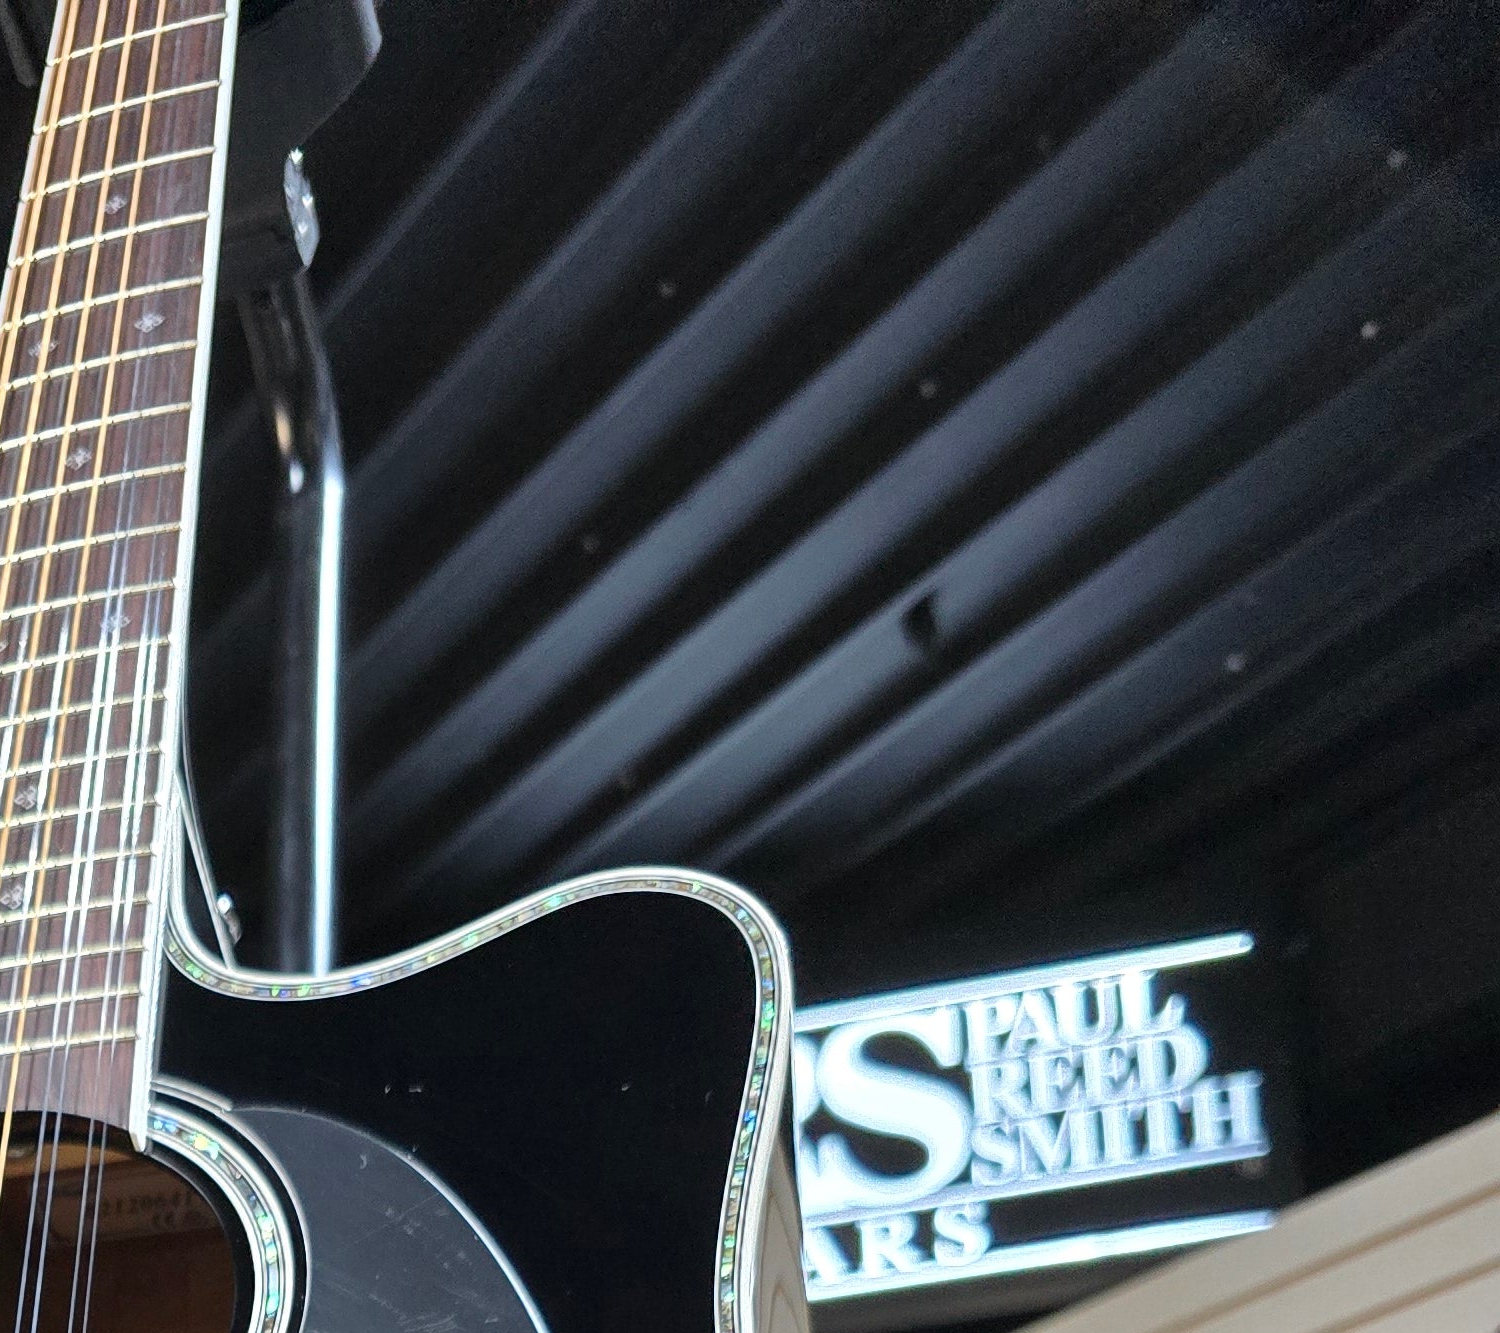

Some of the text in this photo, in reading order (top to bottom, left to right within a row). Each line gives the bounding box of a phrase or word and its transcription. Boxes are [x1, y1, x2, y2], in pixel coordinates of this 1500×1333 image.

[963, 969, 1187, 1068] PAUL
[970, 1022, 1209, 1124] REED
[969, 1070, 1269, 1187] SMITH
